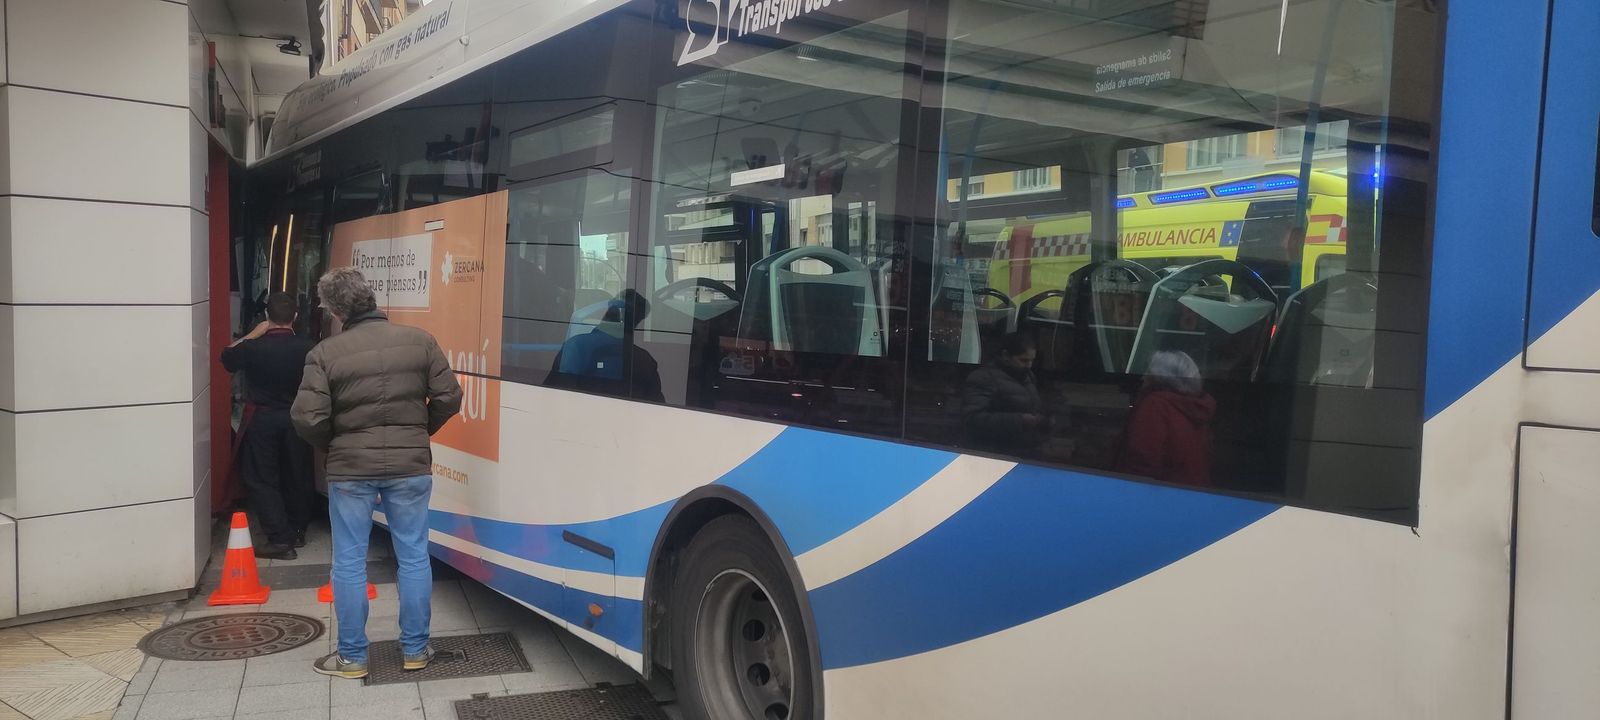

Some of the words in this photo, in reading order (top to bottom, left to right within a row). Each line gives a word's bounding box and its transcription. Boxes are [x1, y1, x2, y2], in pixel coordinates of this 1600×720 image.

[738, 0, 831, 37] Transpor
[337, 50, 377, 89] Propulsado
[379, 42, 395, 65] con
[395, 32, 414, 60] gas
[414, 2, 453, 45] natural
[1095, 81, 1116, 93] Salida
[1117, 78, 1126, 88] de
[1128, 71, 1170, 86] emergencia
[377, 254, 404, 268] menos
[406, 249, 416, 266] de
[455, 260, 485, 273] ZERCANA
[447, 338, 489, 423] QUÍ
[432, 463, 469, 486] rcana.com
